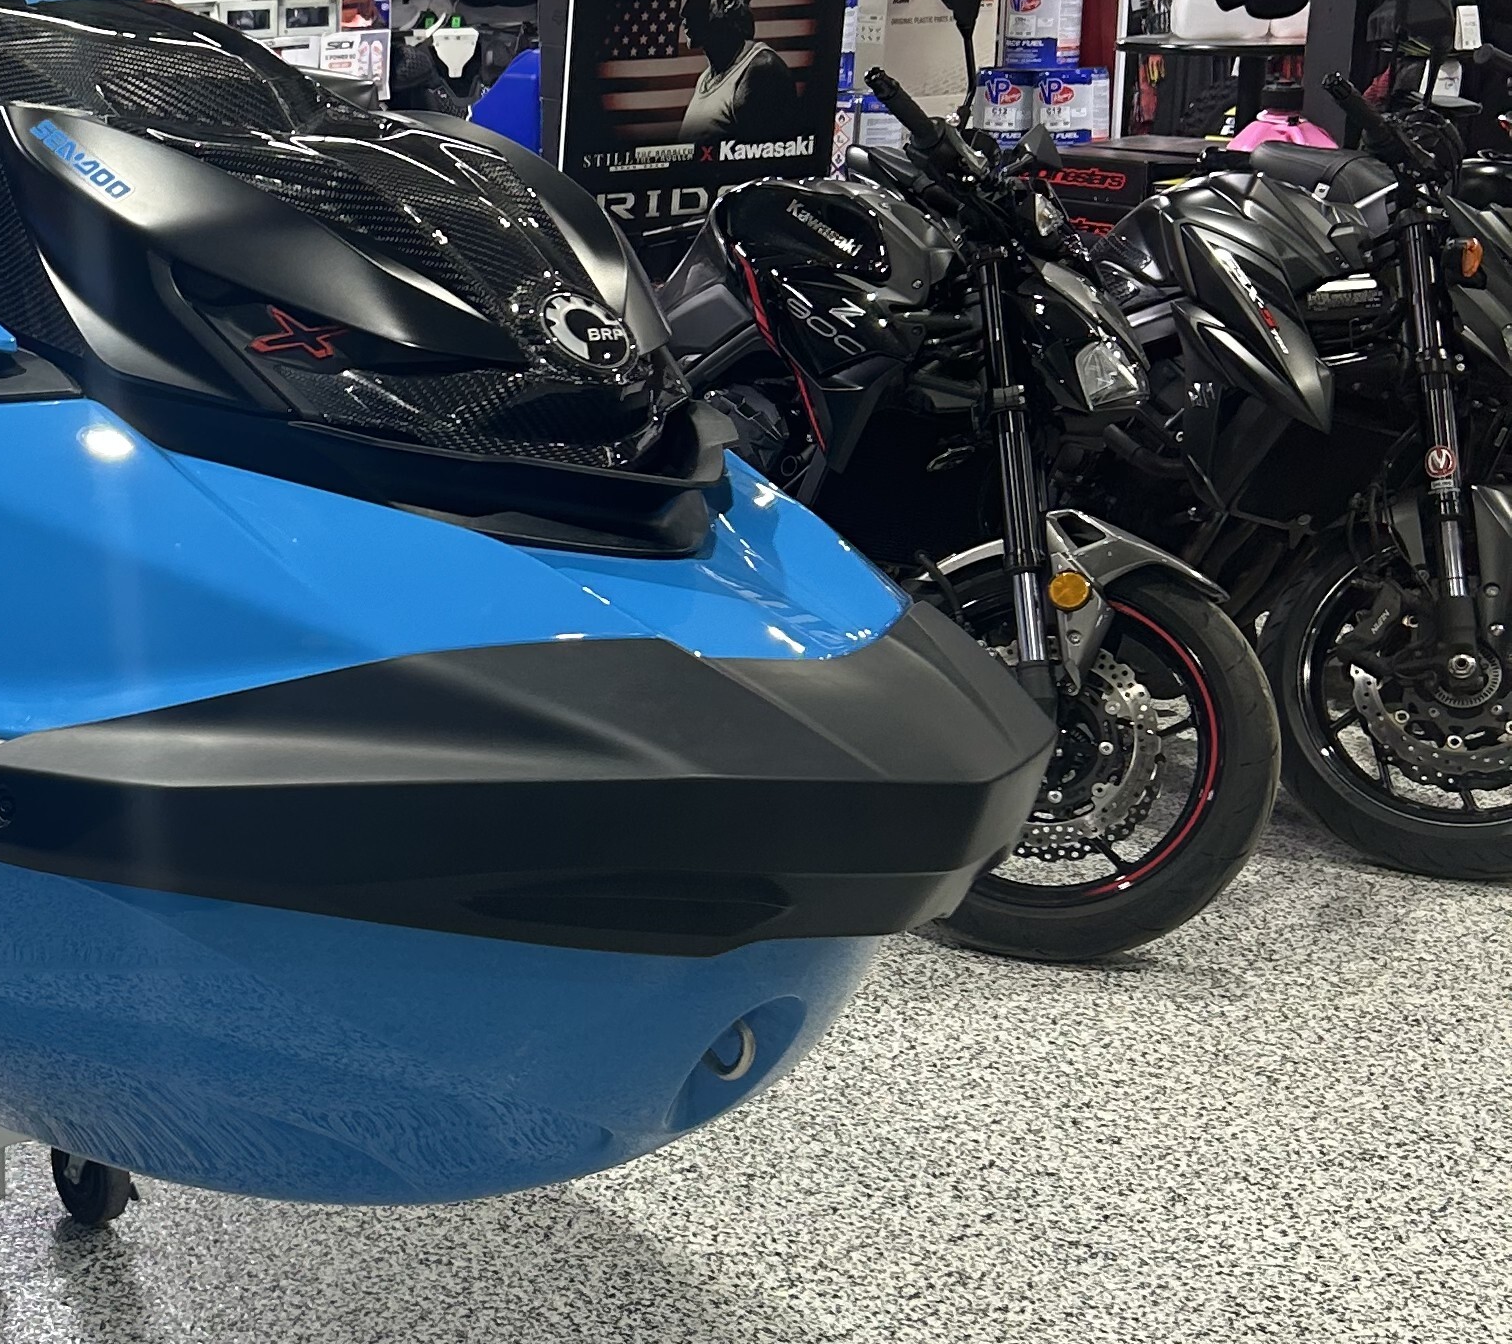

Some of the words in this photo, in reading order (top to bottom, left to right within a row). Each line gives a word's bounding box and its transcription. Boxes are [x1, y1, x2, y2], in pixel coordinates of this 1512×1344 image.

[582, 151, 634, 168] STILL
[719, 135, 815, 161] Kawasaki
[1056, 131, 1079, 139] FUEL
[786, 198, 863, 257] Kawasaki
[587, 327, 624, 342] BRP
[787, 298, 867, 356] 900
